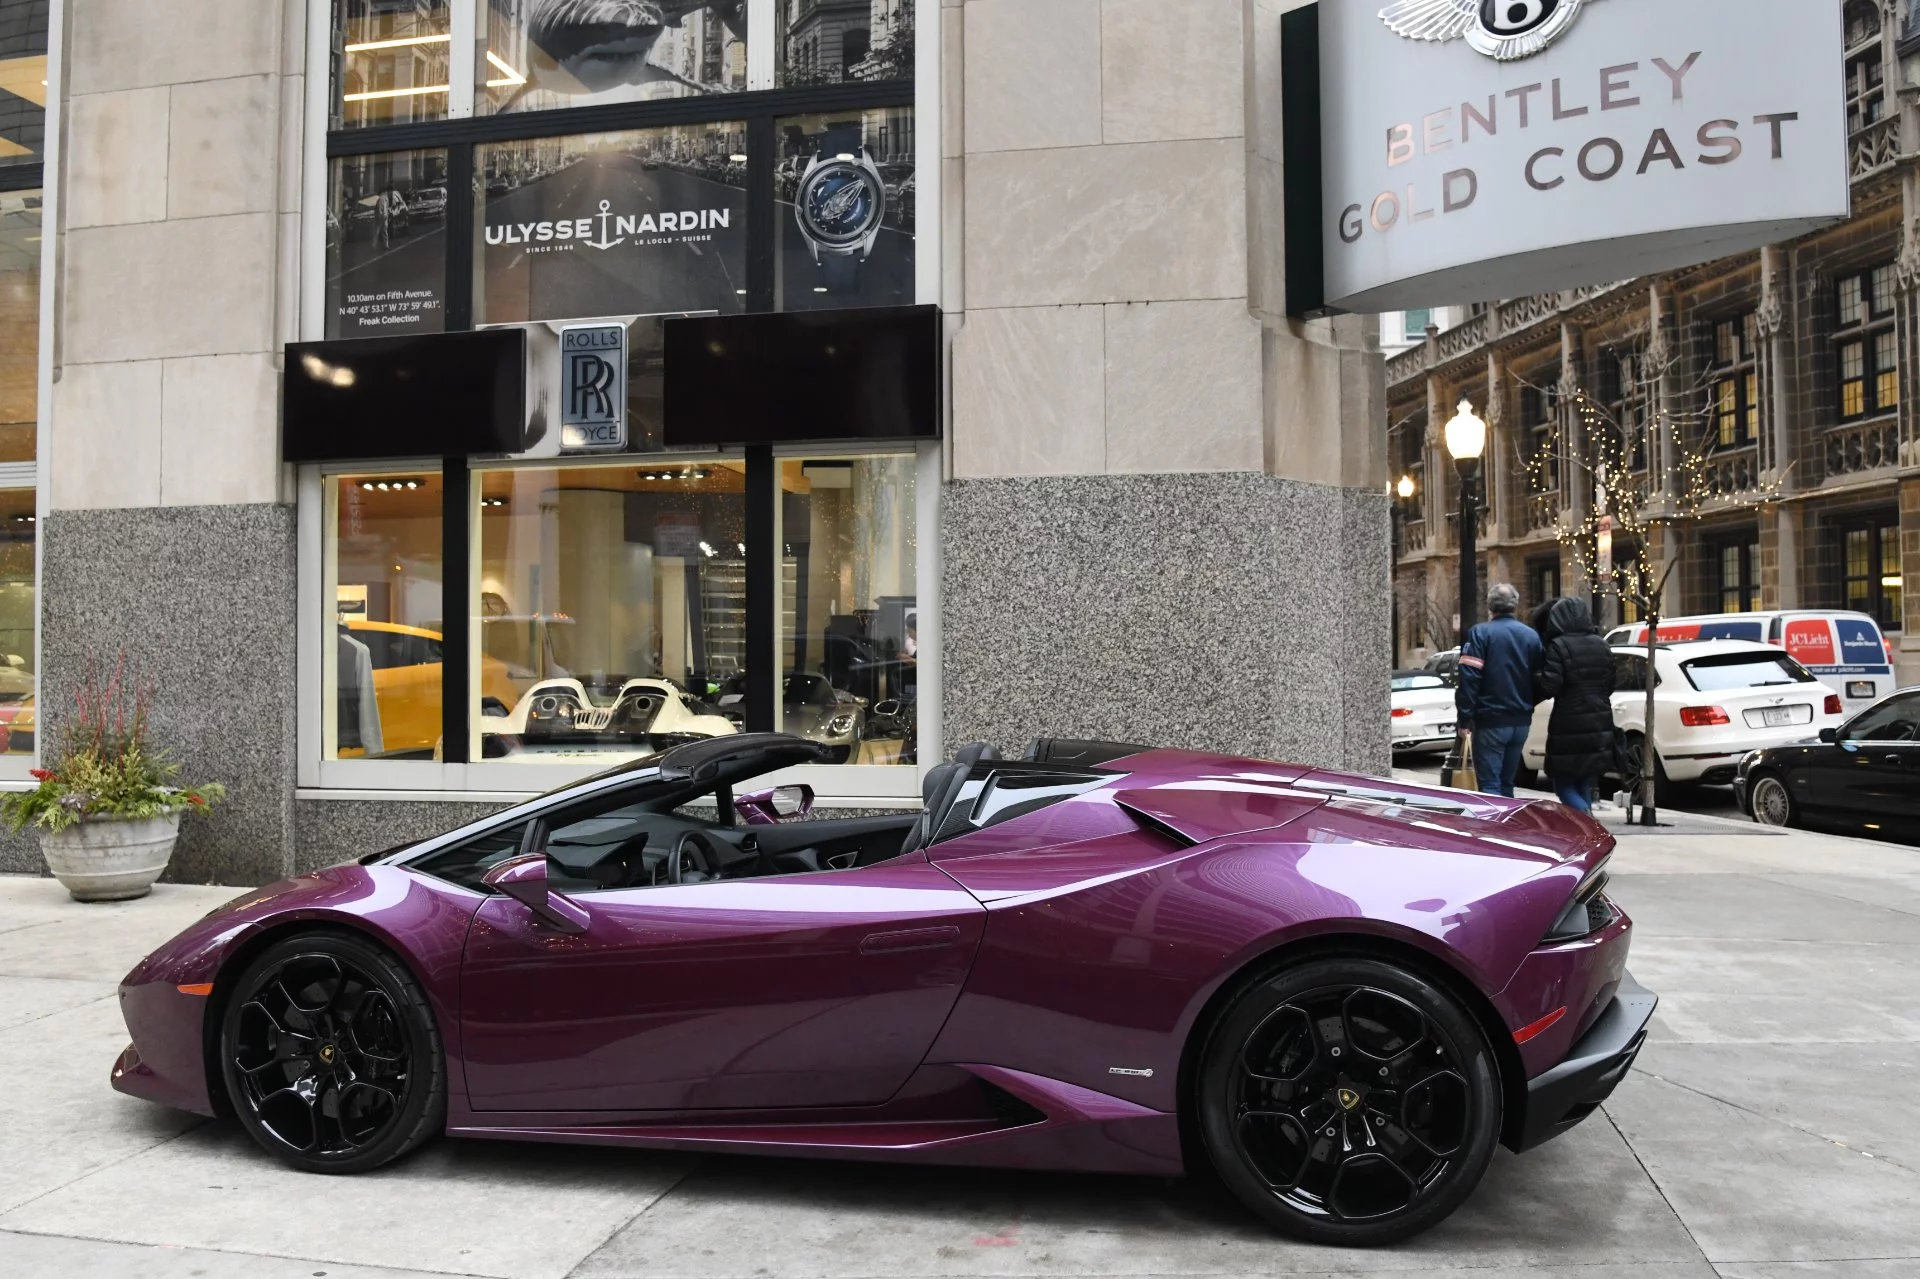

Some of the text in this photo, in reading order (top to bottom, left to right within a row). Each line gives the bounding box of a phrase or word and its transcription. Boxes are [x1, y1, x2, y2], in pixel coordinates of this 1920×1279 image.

[1386, 51, 1702, 168] BENTLEY
[1338, 112, 1799, 244] GOLD COAST
[485, 208, 730, 245] ULYSSE NARDIN
[647, 237, 672, 245] LOCLE
[525, 246, 551, 254] SINCE
[387, 291, 403, 300] Fifth
[404, 290, 433, 298] Avenue.
[339, 307, 346, 315] N
[389, 303, 397, 312] W
[359, 314, 420, 326] Freak Collection
[566, 331, 618, 346] ROLLS
[1789, 632, 1829, 645] JCLicht
